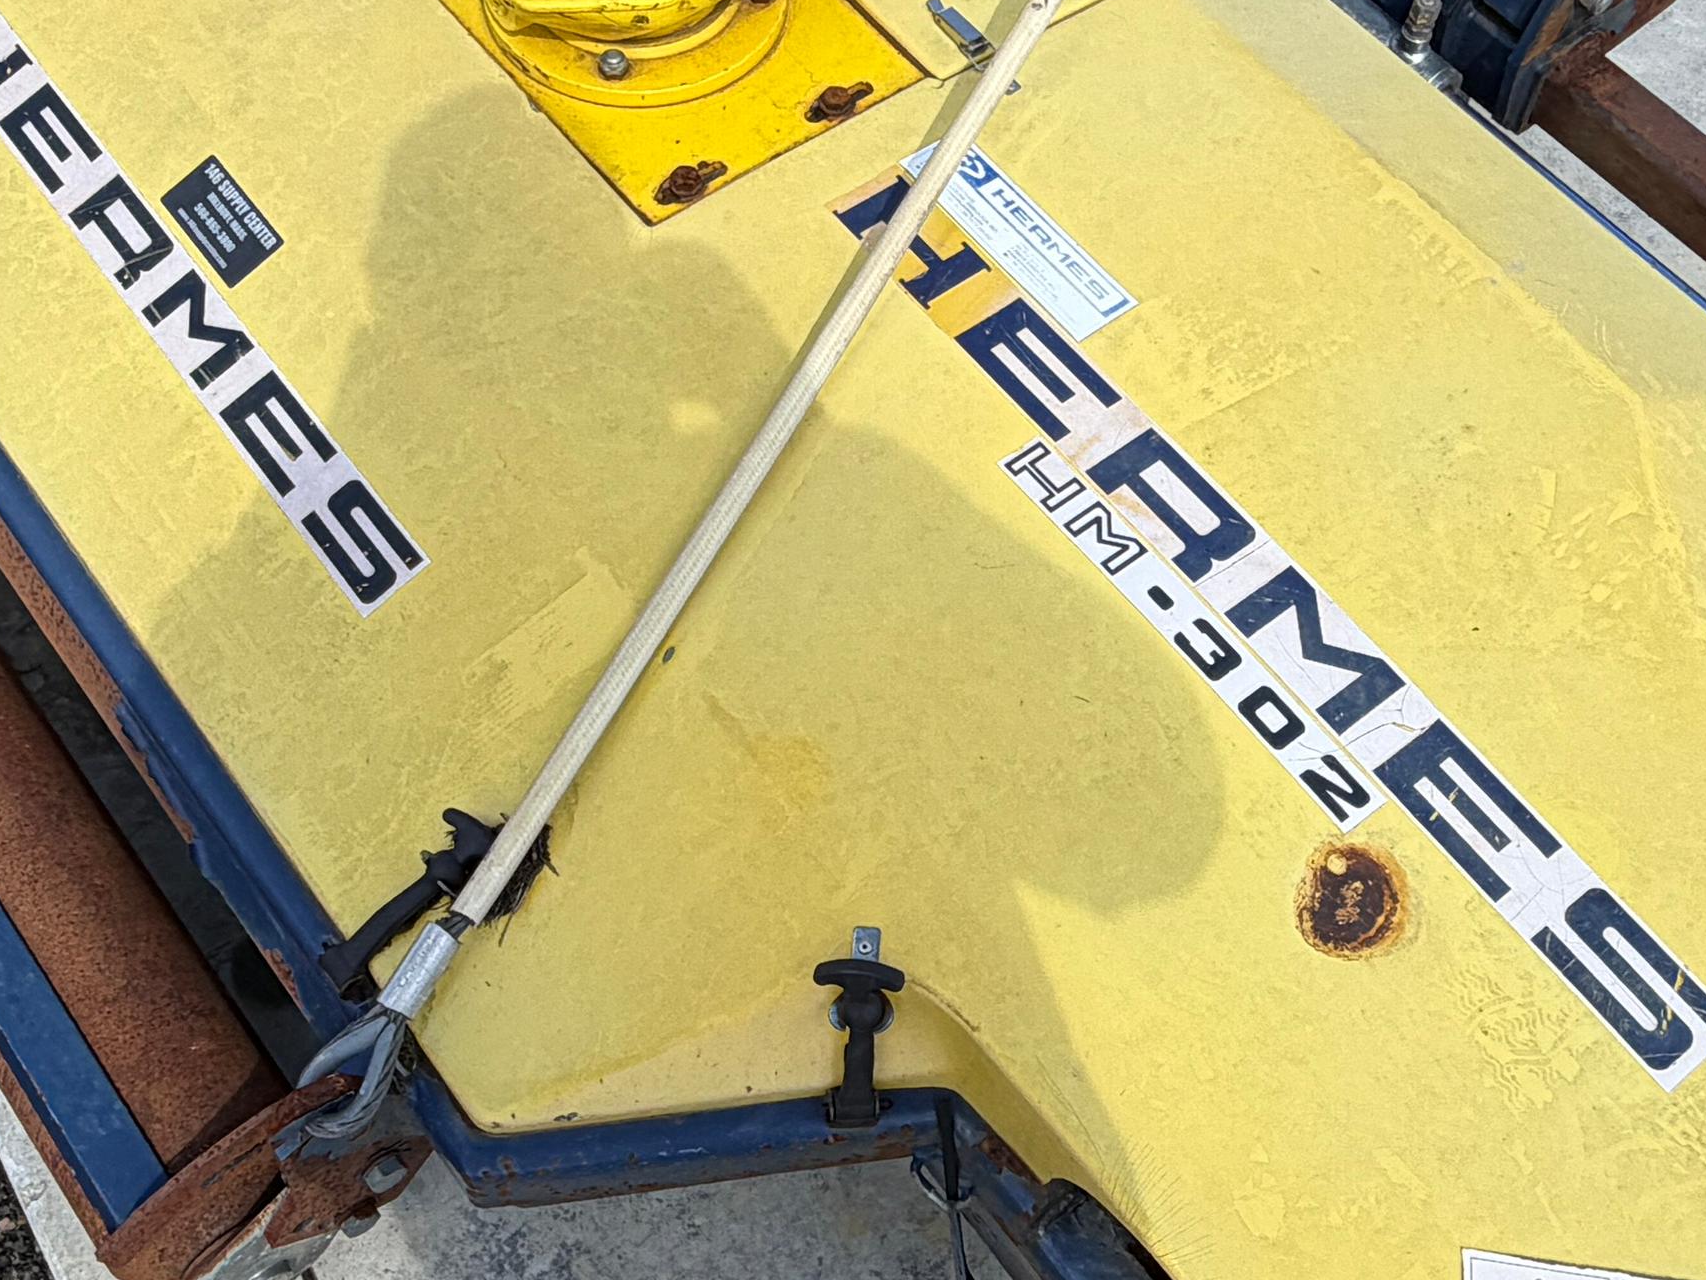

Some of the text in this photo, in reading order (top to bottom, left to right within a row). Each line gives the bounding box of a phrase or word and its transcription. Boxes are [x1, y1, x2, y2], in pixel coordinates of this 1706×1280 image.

[204, 163, 277, 251] 146 SUPPLY CENTER
[991, 188, 1110, 300] HERMES
